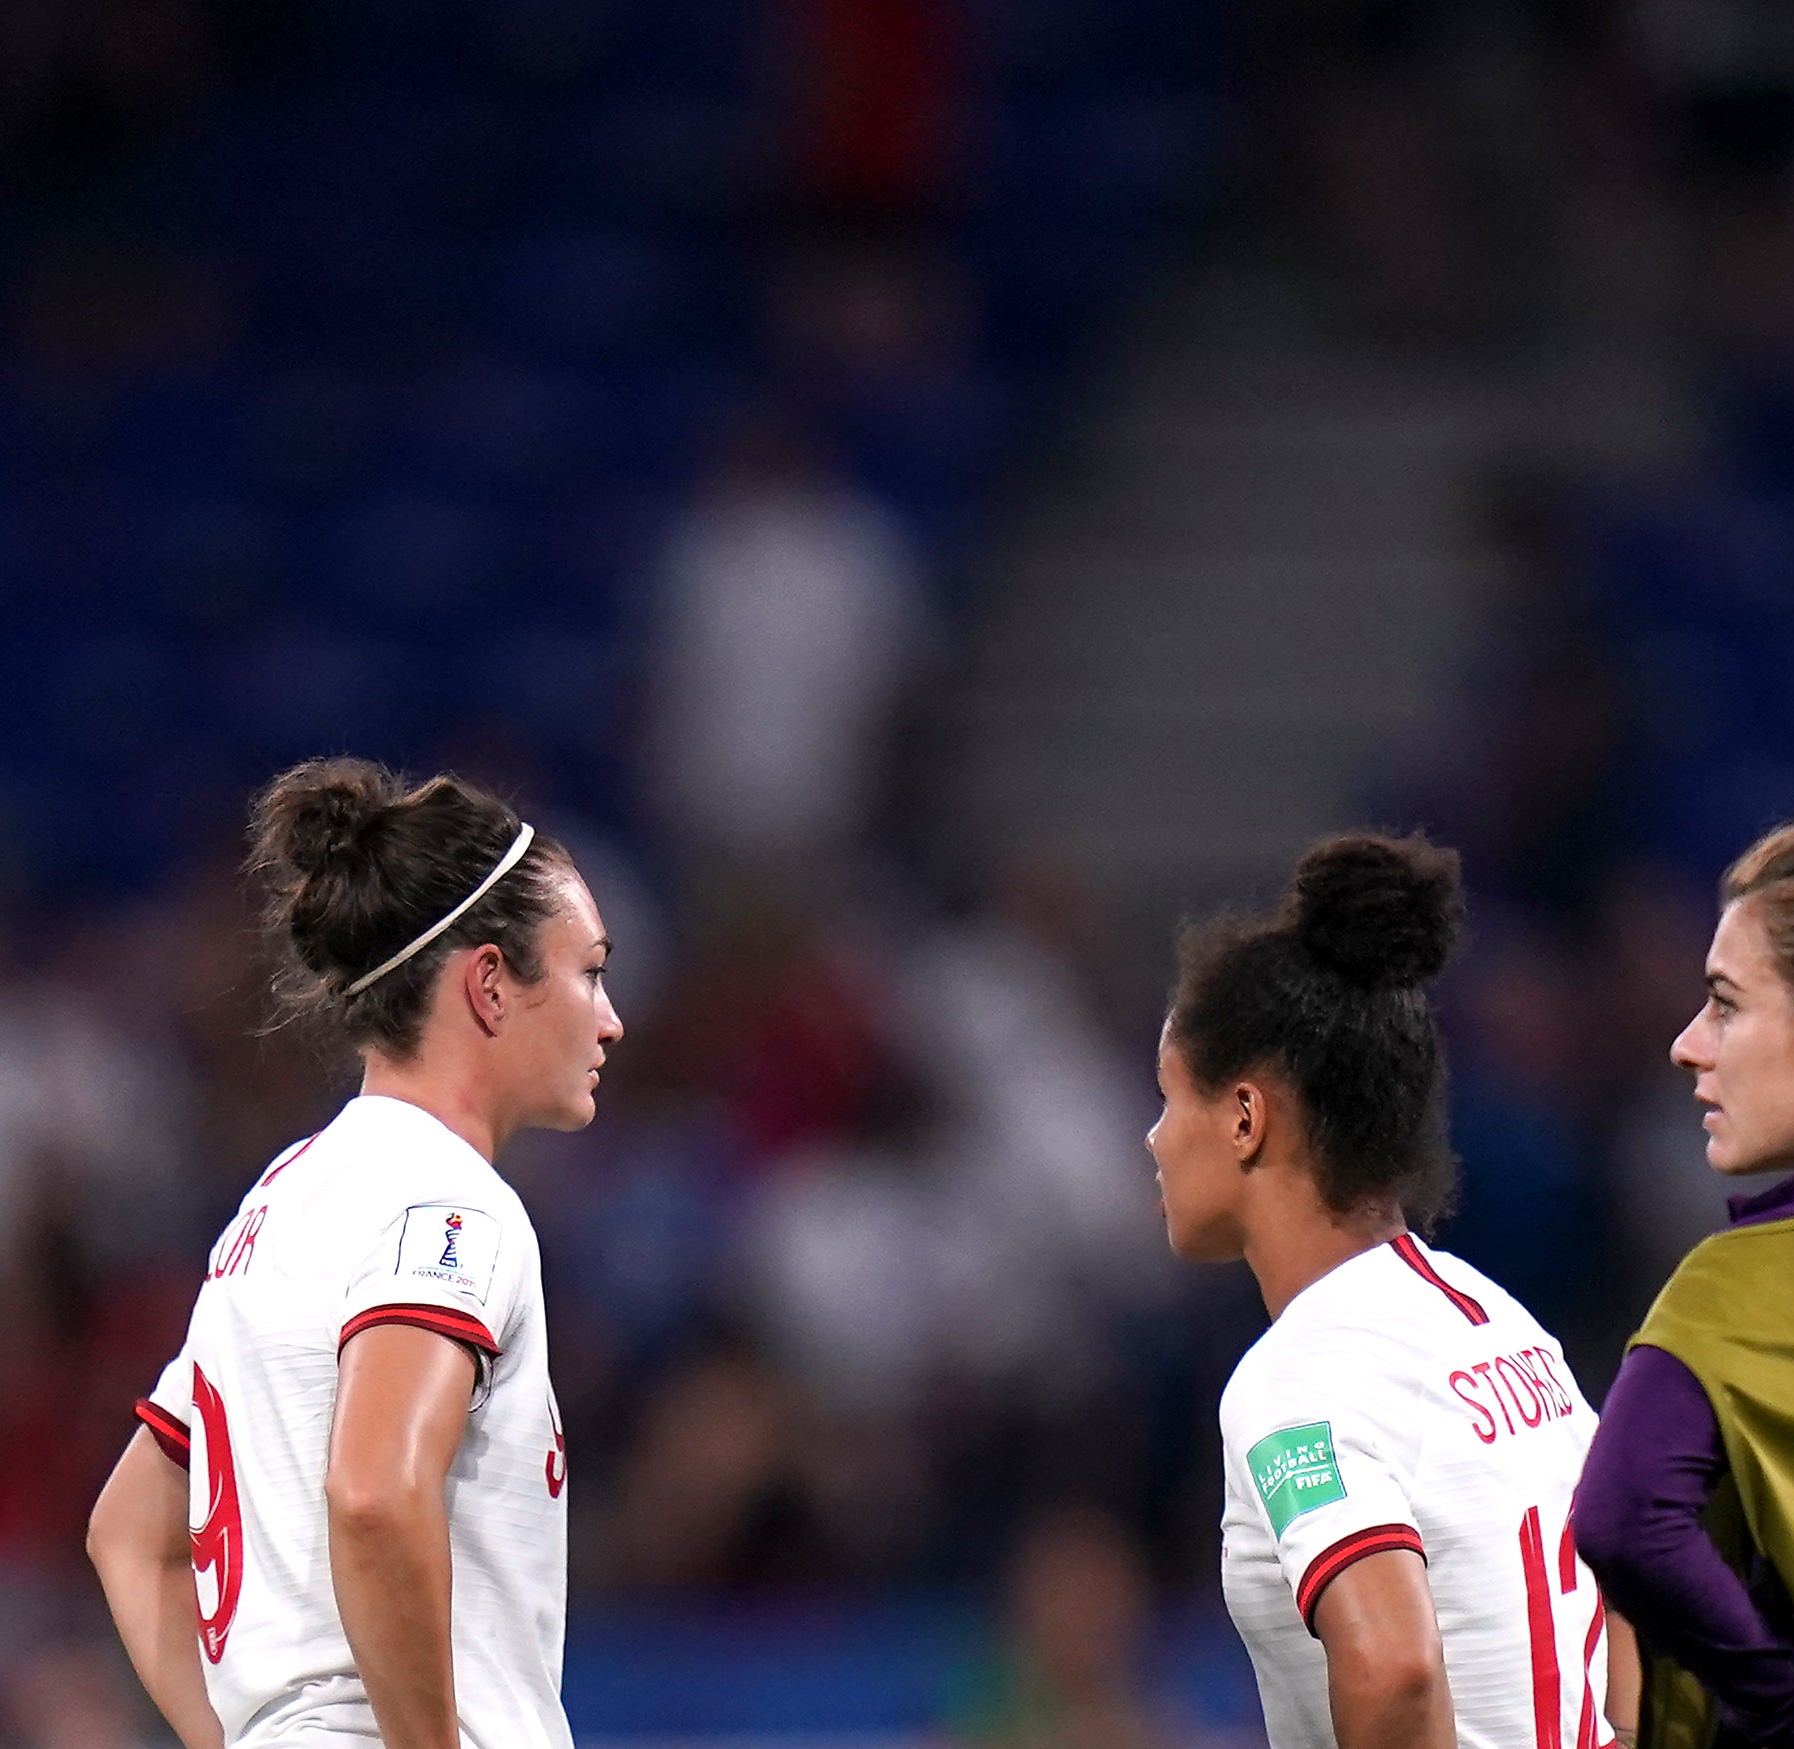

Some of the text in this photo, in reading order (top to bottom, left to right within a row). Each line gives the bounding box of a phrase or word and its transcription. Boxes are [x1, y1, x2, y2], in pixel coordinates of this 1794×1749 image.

[1258, 1441, 1325, 1484] LIVING
[1262, 1449, 1327, 1494] FOOTBALL
[1294, 1471, 1333, 1491] FIFA
[189, 1360, 244, 1665] 9
